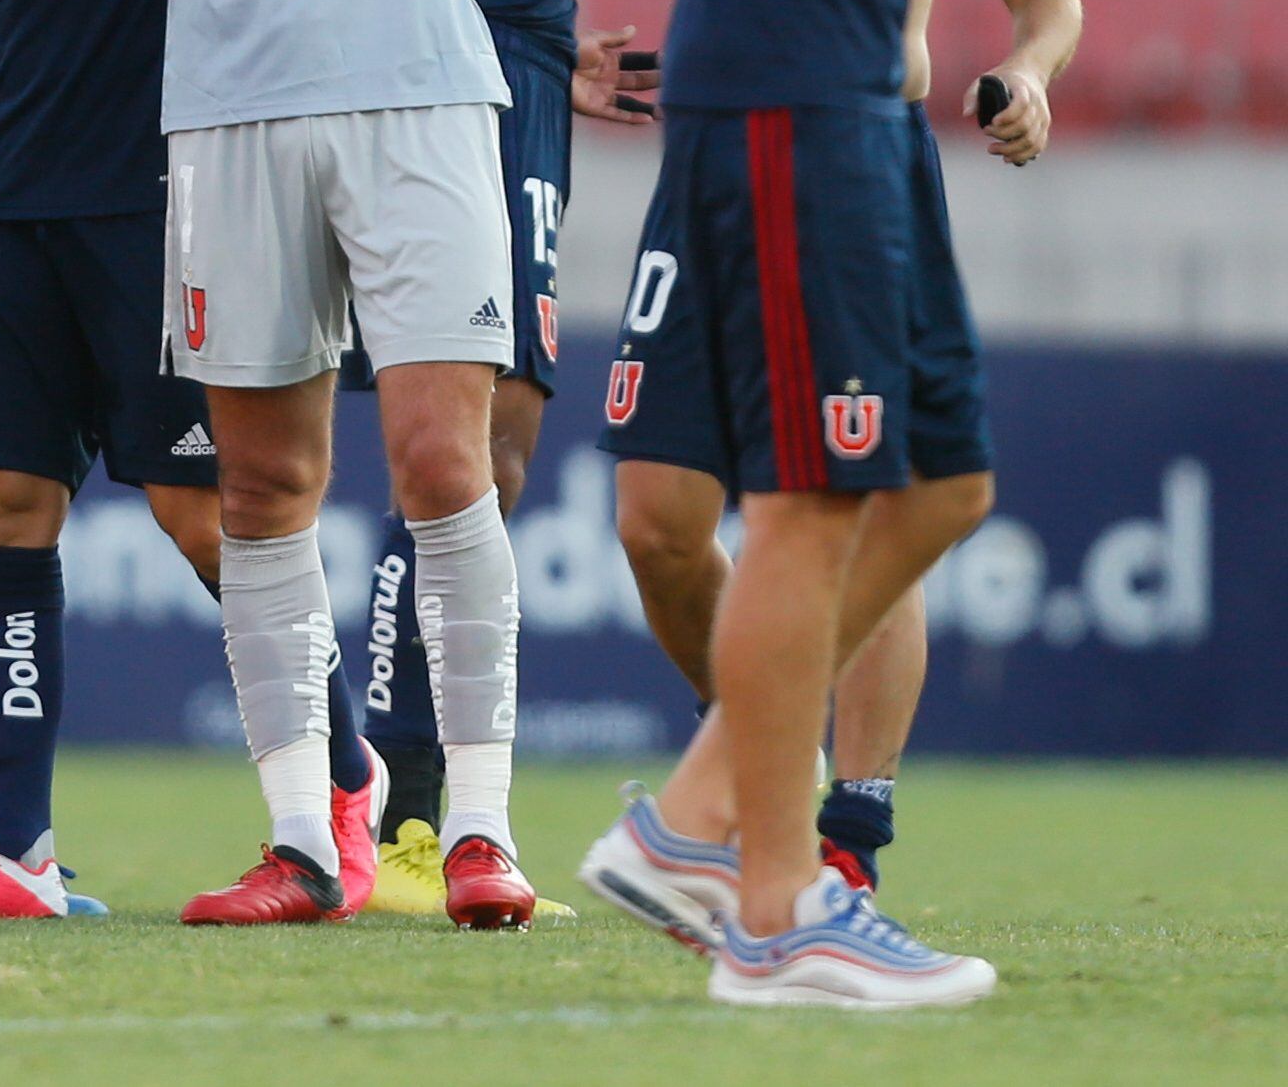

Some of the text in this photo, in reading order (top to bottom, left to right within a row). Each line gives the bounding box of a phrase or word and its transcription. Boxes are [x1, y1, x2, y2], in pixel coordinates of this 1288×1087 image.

[468, 315, 507, 330] adidas
[605, 360, 644, 424] U
[171, 444, 218, 456] adidas
[822, 394, 885, 461] U
[367, 553, 408, 713] Dolorub
